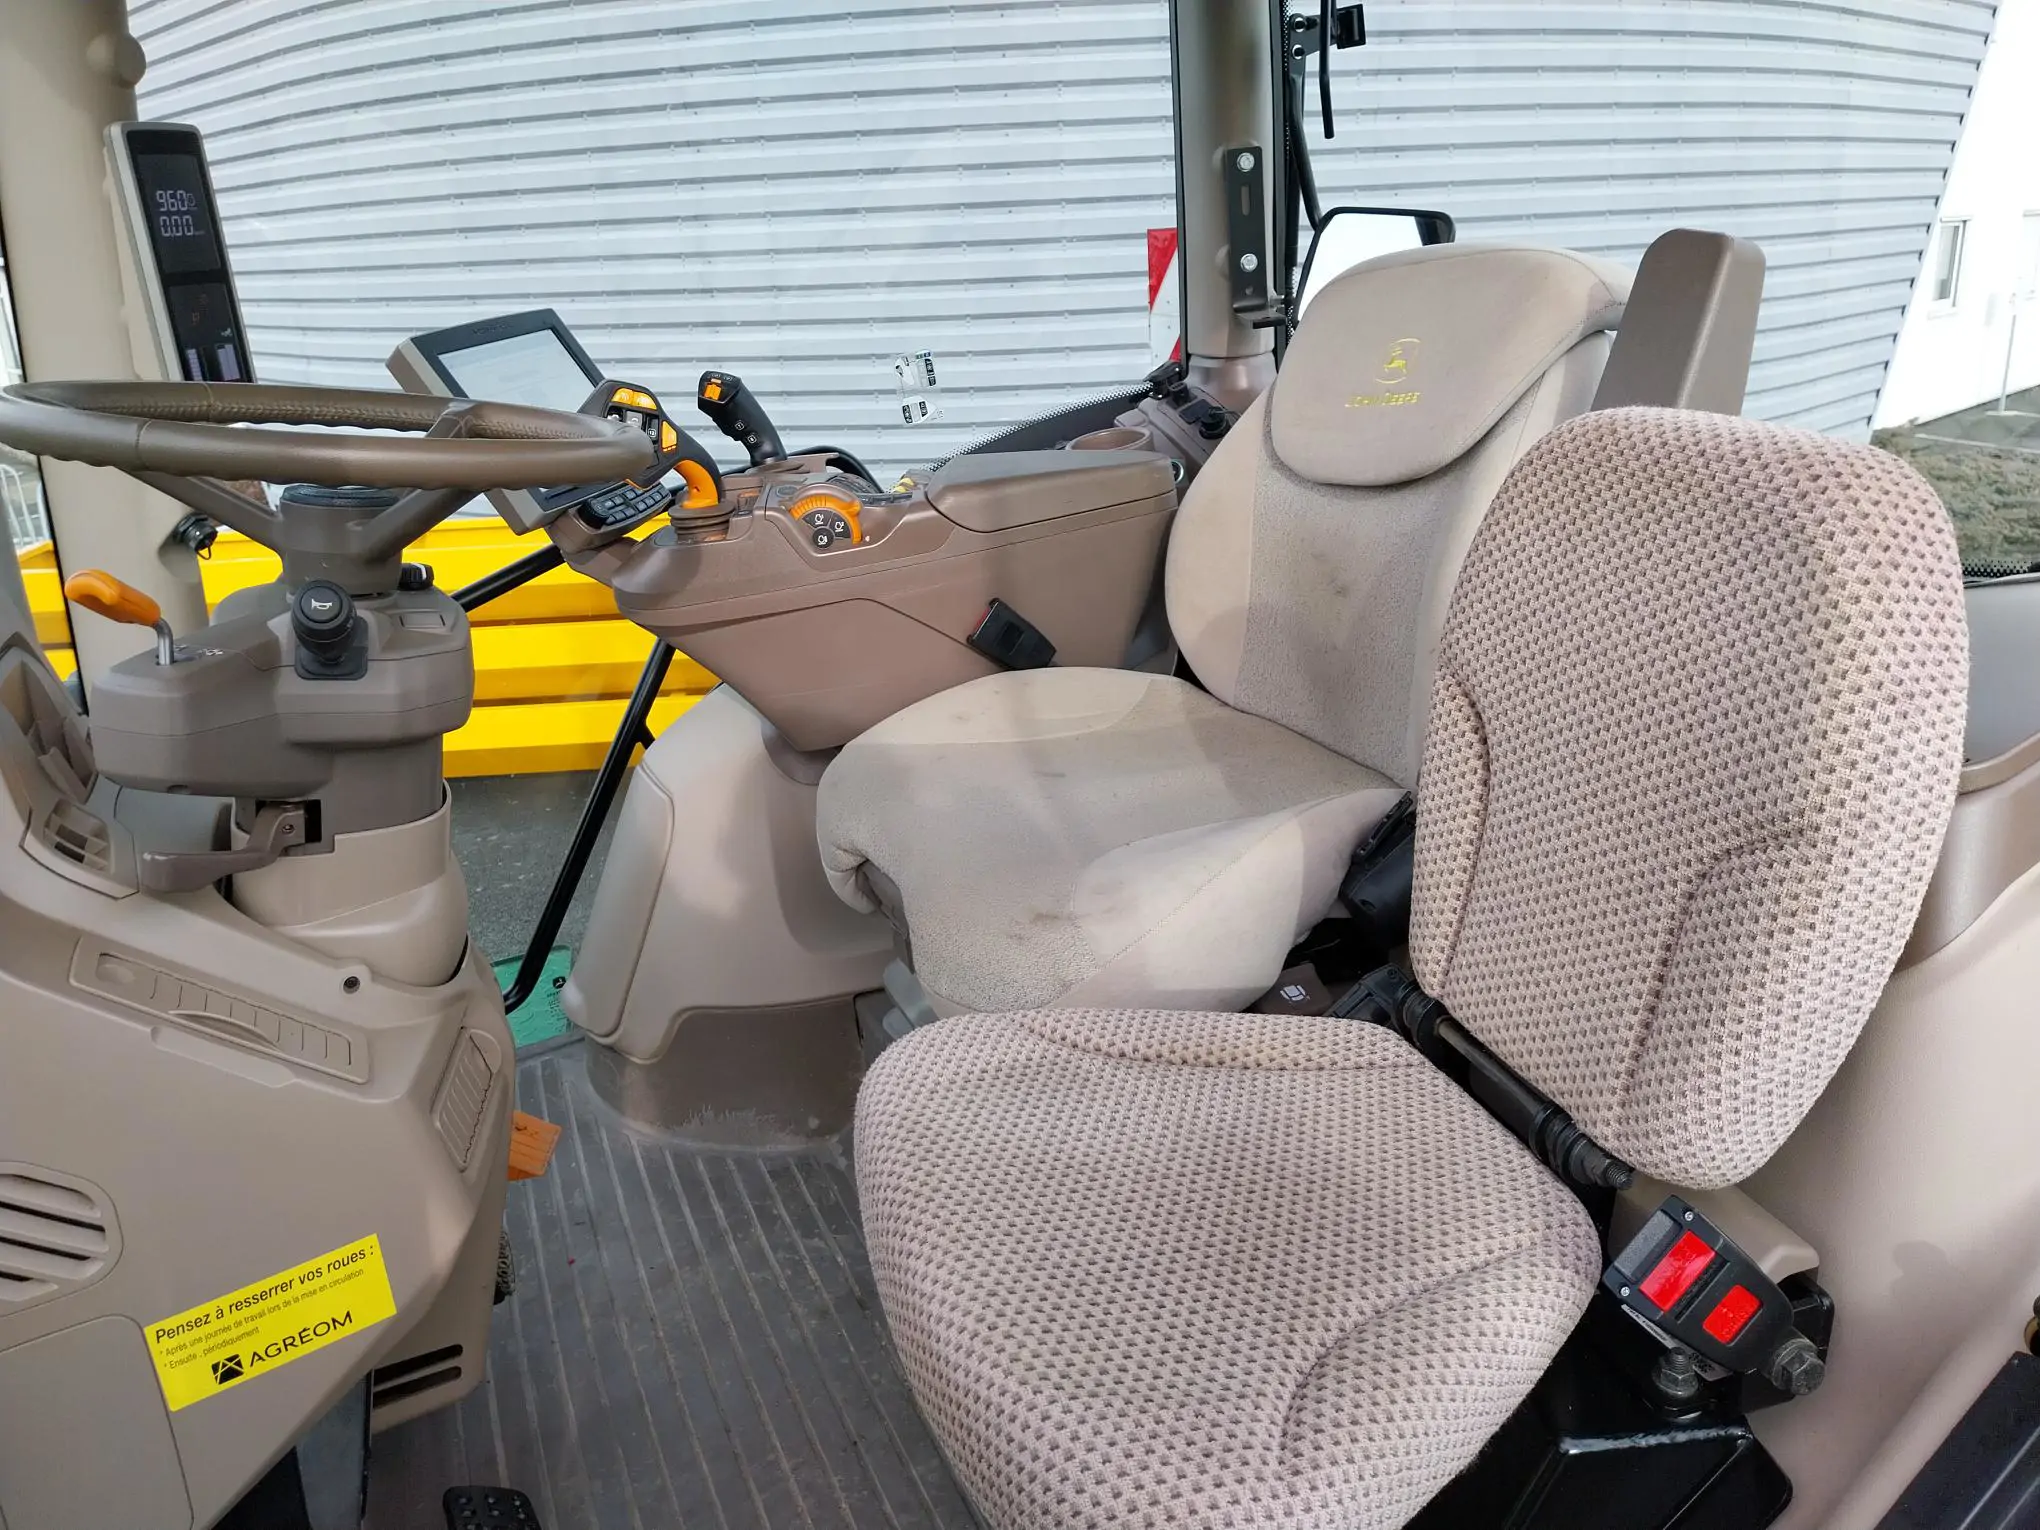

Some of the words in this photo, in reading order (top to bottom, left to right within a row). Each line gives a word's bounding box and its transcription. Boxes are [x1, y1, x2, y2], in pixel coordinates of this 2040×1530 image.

[155, 1312, 212, 1344] Pensez
[215, 1305, 225, 1320] à
[229, 1277, 295, 1315] resserrer
[298, 1264, 324, 1284] vos
[327, 1247, 367, 1274] roues
[165, 1341, 188, 1357] Après
[189, 1335, 203, 1347] une
[204, 1323, 232, 1344] journée
[233, 1318, 243, 1330] de
[244, 1309, 267, 1325] travail
[267, 1303, 282, 1317] lors
[282, 1297, 292, 1309] de
[293, 1294, 300, 1304] la
[301, 1288, 318, 1300] mise
[318, 1283, 328, 1293] en
[328, 1268, 364, 1289] circulation
[169, 1352, 197, 1369] Ensuite
[203, 1325, 260, 1356] périodiquement
[249, 1310, 354, 1368] AGRÉOM
